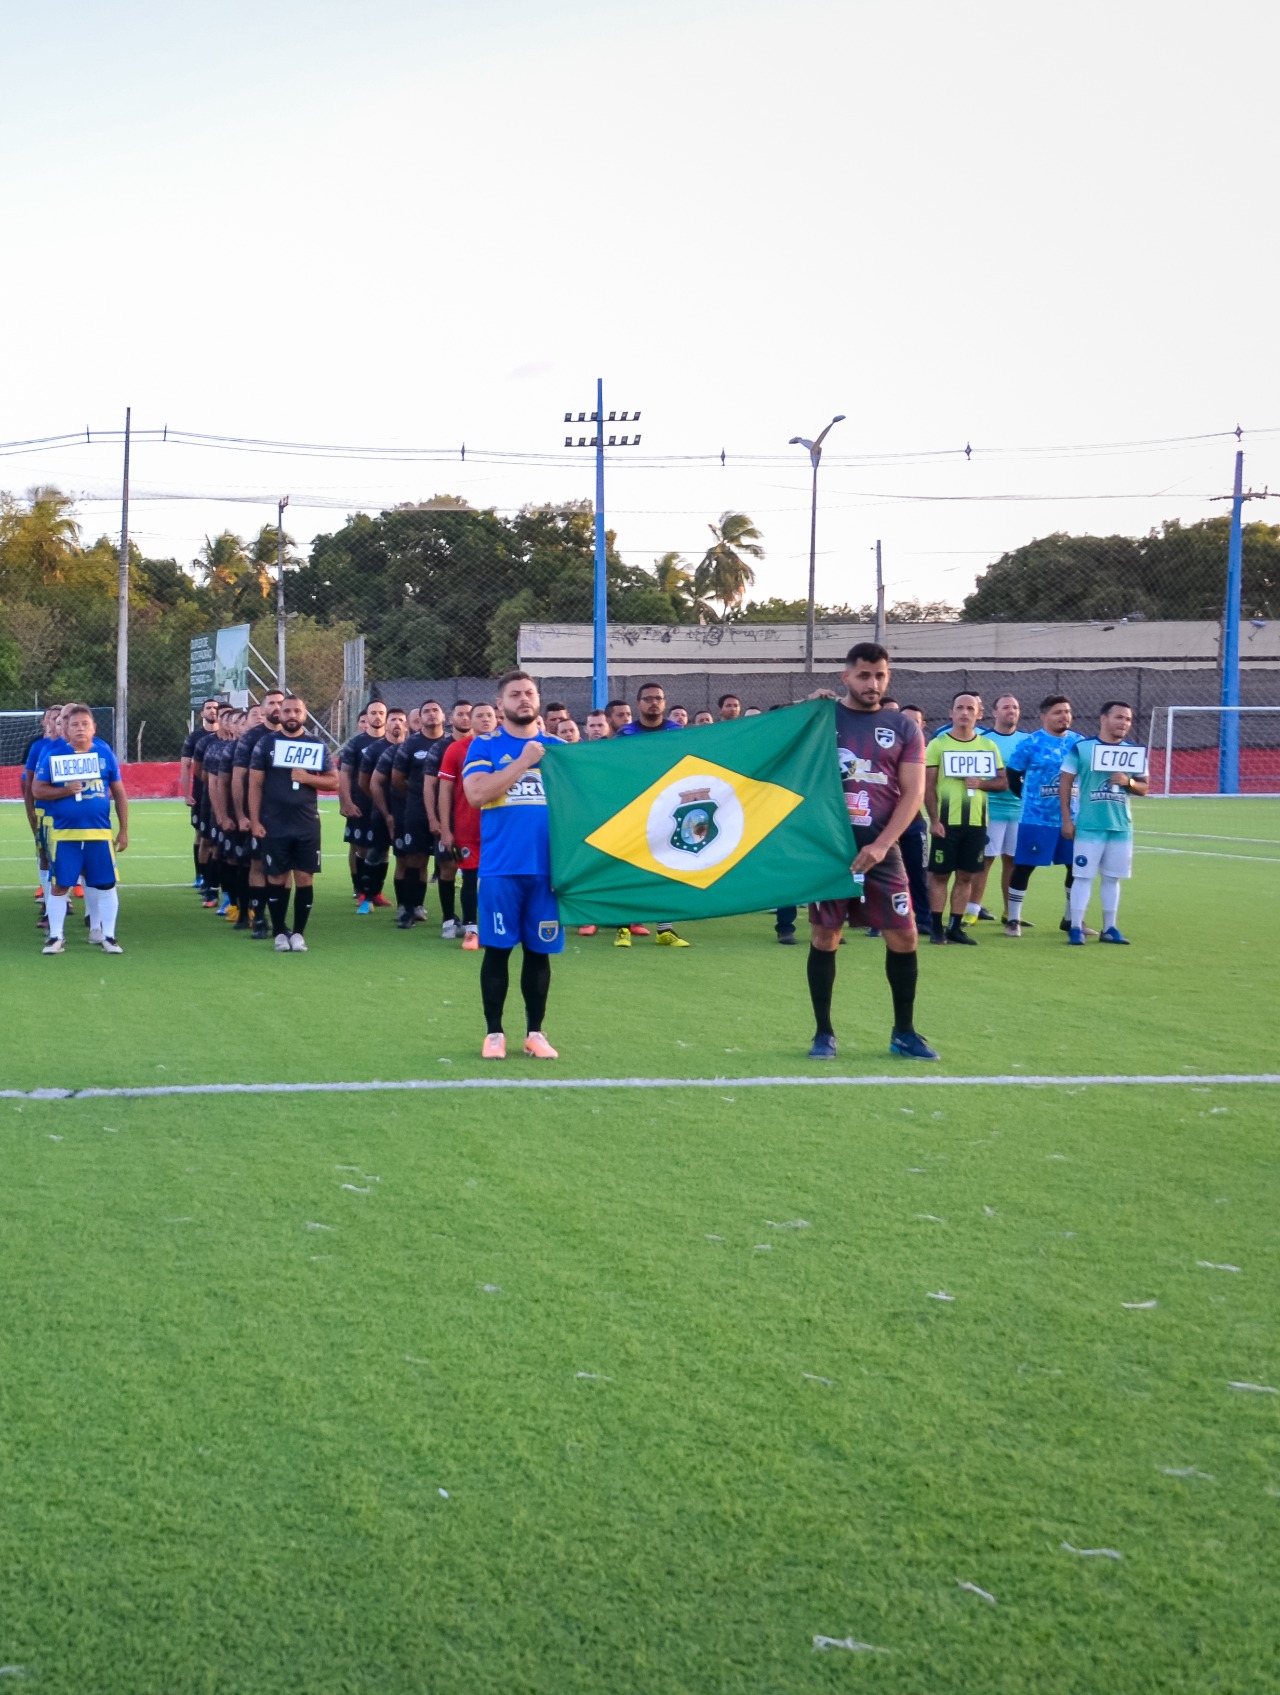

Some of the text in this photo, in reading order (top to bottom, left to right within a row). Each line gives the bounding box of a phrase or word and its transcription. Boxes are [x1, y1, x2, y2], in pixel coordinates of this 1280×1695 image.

[284, 745, 318, 766] GAP1
[1100, 750, 1138, 768] CTOC
[54, 757, 98, 776] ALBERGADO
[935, 849, 944, 864] 5
[493, 911, 506, 935] 13
